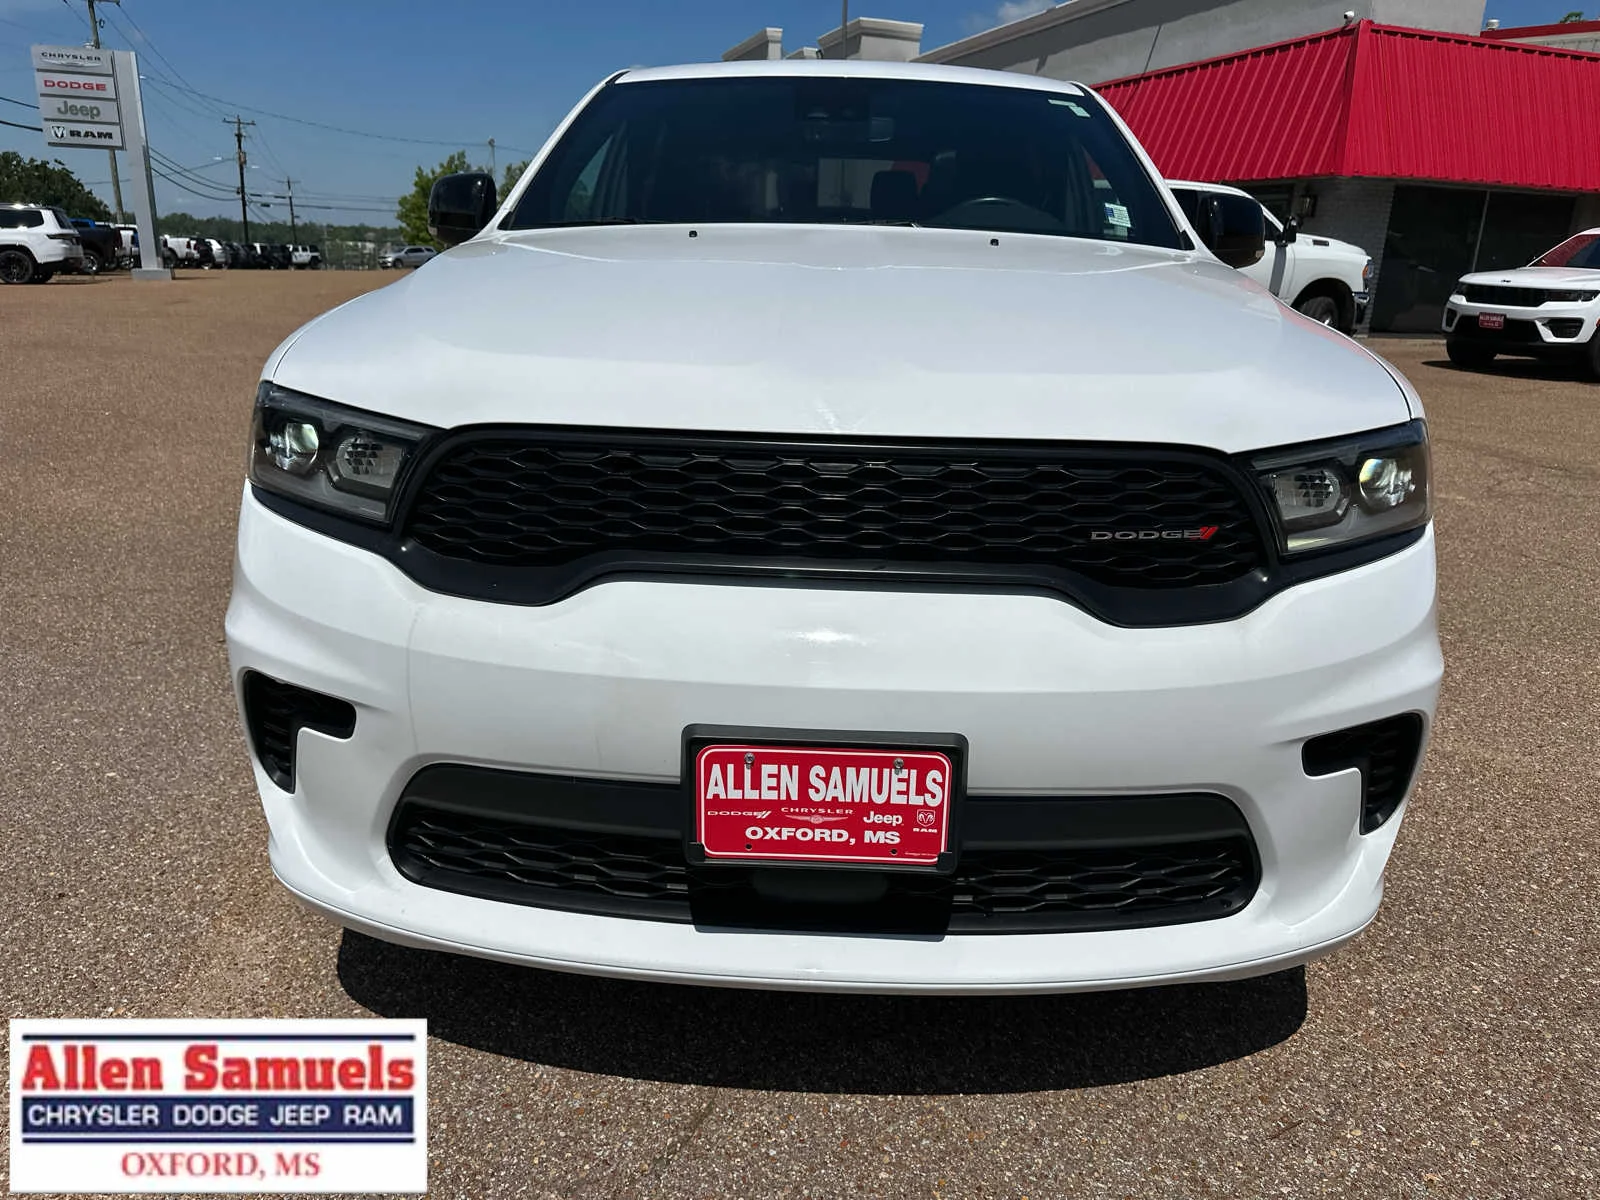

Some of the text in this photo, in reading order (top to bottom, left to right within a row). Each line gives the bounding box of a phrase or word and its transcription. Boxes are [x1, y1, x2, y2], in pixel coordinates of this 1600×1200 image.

[41, 51, 101, 61] CHRYSLER
[44, 80, 106, 91] DODGE
[57, 101, 100, 119] Jeep
[69, 130, 112, 139] RAM
[1091, 530, 1201, 540] DODGE
[706, 763, 943, 807] ALLEN SAMUELS
[781, 807, 853, 815] CHRYSLER
[863, 811, 902, 826] Jeep
[745, 826, 901, 845] OXFORD, MS
